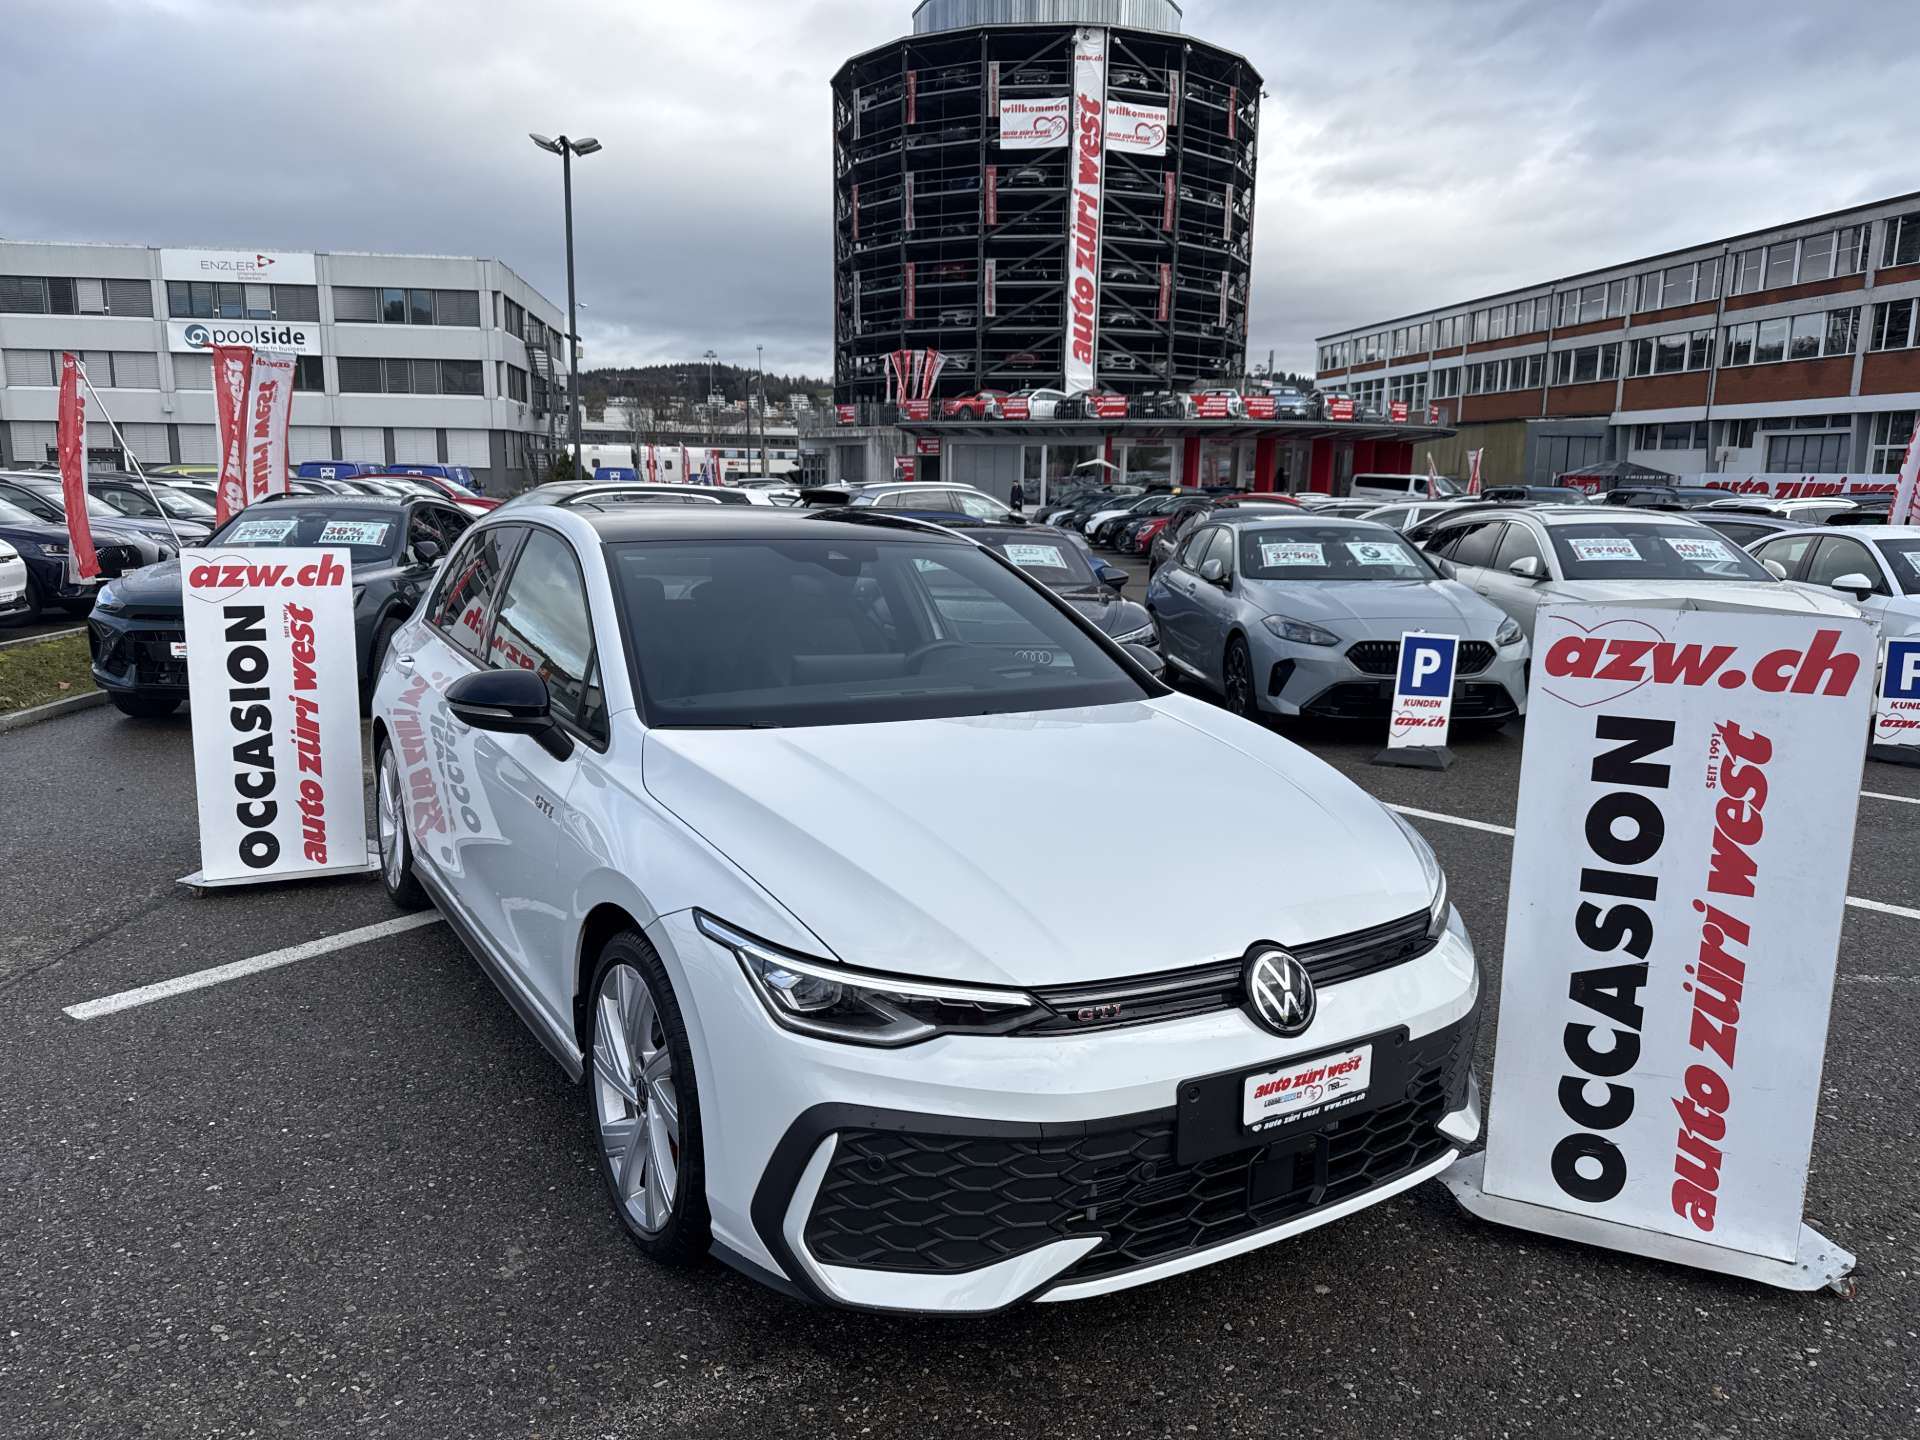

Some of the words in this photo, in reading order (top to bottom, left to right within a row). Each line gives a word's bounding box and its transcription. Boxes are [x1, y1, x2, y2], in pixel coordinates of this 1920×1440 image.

[1002, 103, 1067, 114] willkommen
[1108, 106, 1166, 121] willkommen
[1077, 93, 1101, 185] west
[1071, 188, 1099, 276] züri
[200, 260, 255, 271] ENZLER
[213, 325, 305, 345] poolside
[1071, 276, 1095, 365] auto
[325, 527, 364, 536] 36%
[189, 554, 345, 588] azw.ch
[283, 602, 318, 690] west
[1544, 629, 1861, 697] azw.ch
[1411, 648, 1441, 688] P
[1394, 716, 1446, 727] azw.ch
[1403, 698, 1442, 709] KUNDEN
[223, 605, 280, 869] OCCASION
[288, 694, 323, 778] züri
[1708, 733, 1721, 760] 1991
[1705, 764, 1718, 789] SEIT
[295, 779, 328, 865] auto
[535, 795, 554, 818] GTI
[1707, 719, 1773, 898] west
[1551, 714, 1676, 1203] OCCASION
[1682, 898, 1752, 1070] züri
[1077, 1003, 1122, 1022] GTI
[1254, 1077, 1292, 1099] auto
[1292, 1064, 1328, 1089] züri
[1327, 1056, 1362, 1078] west
[1263, 1118, 1282, 1130] auto
[1283, 1112, 1301, 1124] züri
[1302, 1106, 1320, 1118] west
[1324, 1092, 1366, 1111] www.azw.ch
[1671, 1064, 1730, 1232] auto
